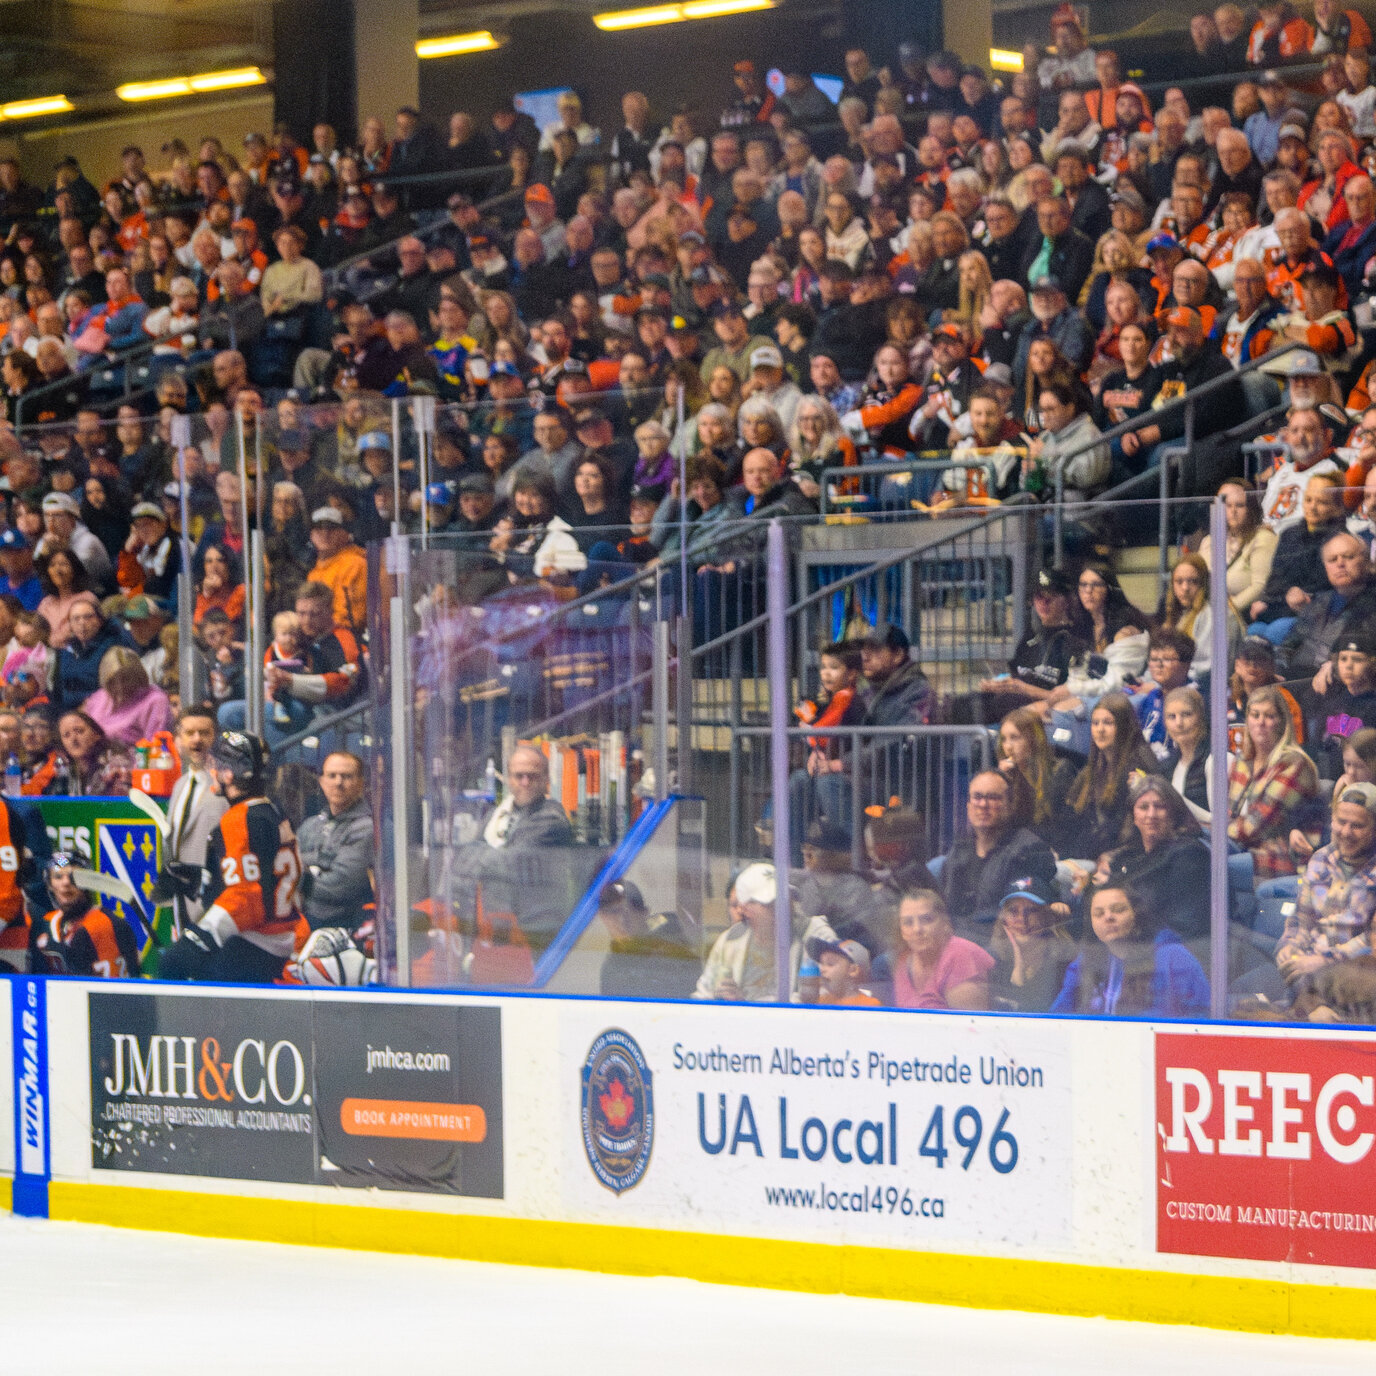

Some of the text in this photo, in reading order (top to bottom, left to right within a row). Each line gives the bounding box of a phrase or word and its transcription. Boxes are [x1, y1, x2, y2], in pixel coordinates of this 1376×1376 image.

[221, 852, 260, 886] 26
[104, 1033, 313, 1106] JMH&CO.
[366, 1044, 451, 1074] jmhca.com
[672, 1042, 762, 1075] Southern
[769, 1047, 860, 1079] Alberta's
[868, 1051, 972, 1087] Pipetrade
[979, 1056, 1044, 1088] Union
[105, 1102, 312, 1134] CHARTERED PROFESSIONAL ACCOUNTANTS
[354, 1109, 472, 1131] BOOK APPOINTMENT
[697, 1091, 1019, 1174] UA Local 496
[765, 1183, 945, 1218] www.local496.ca
[1166, 1200, 1232, 1223] CUSTOM
